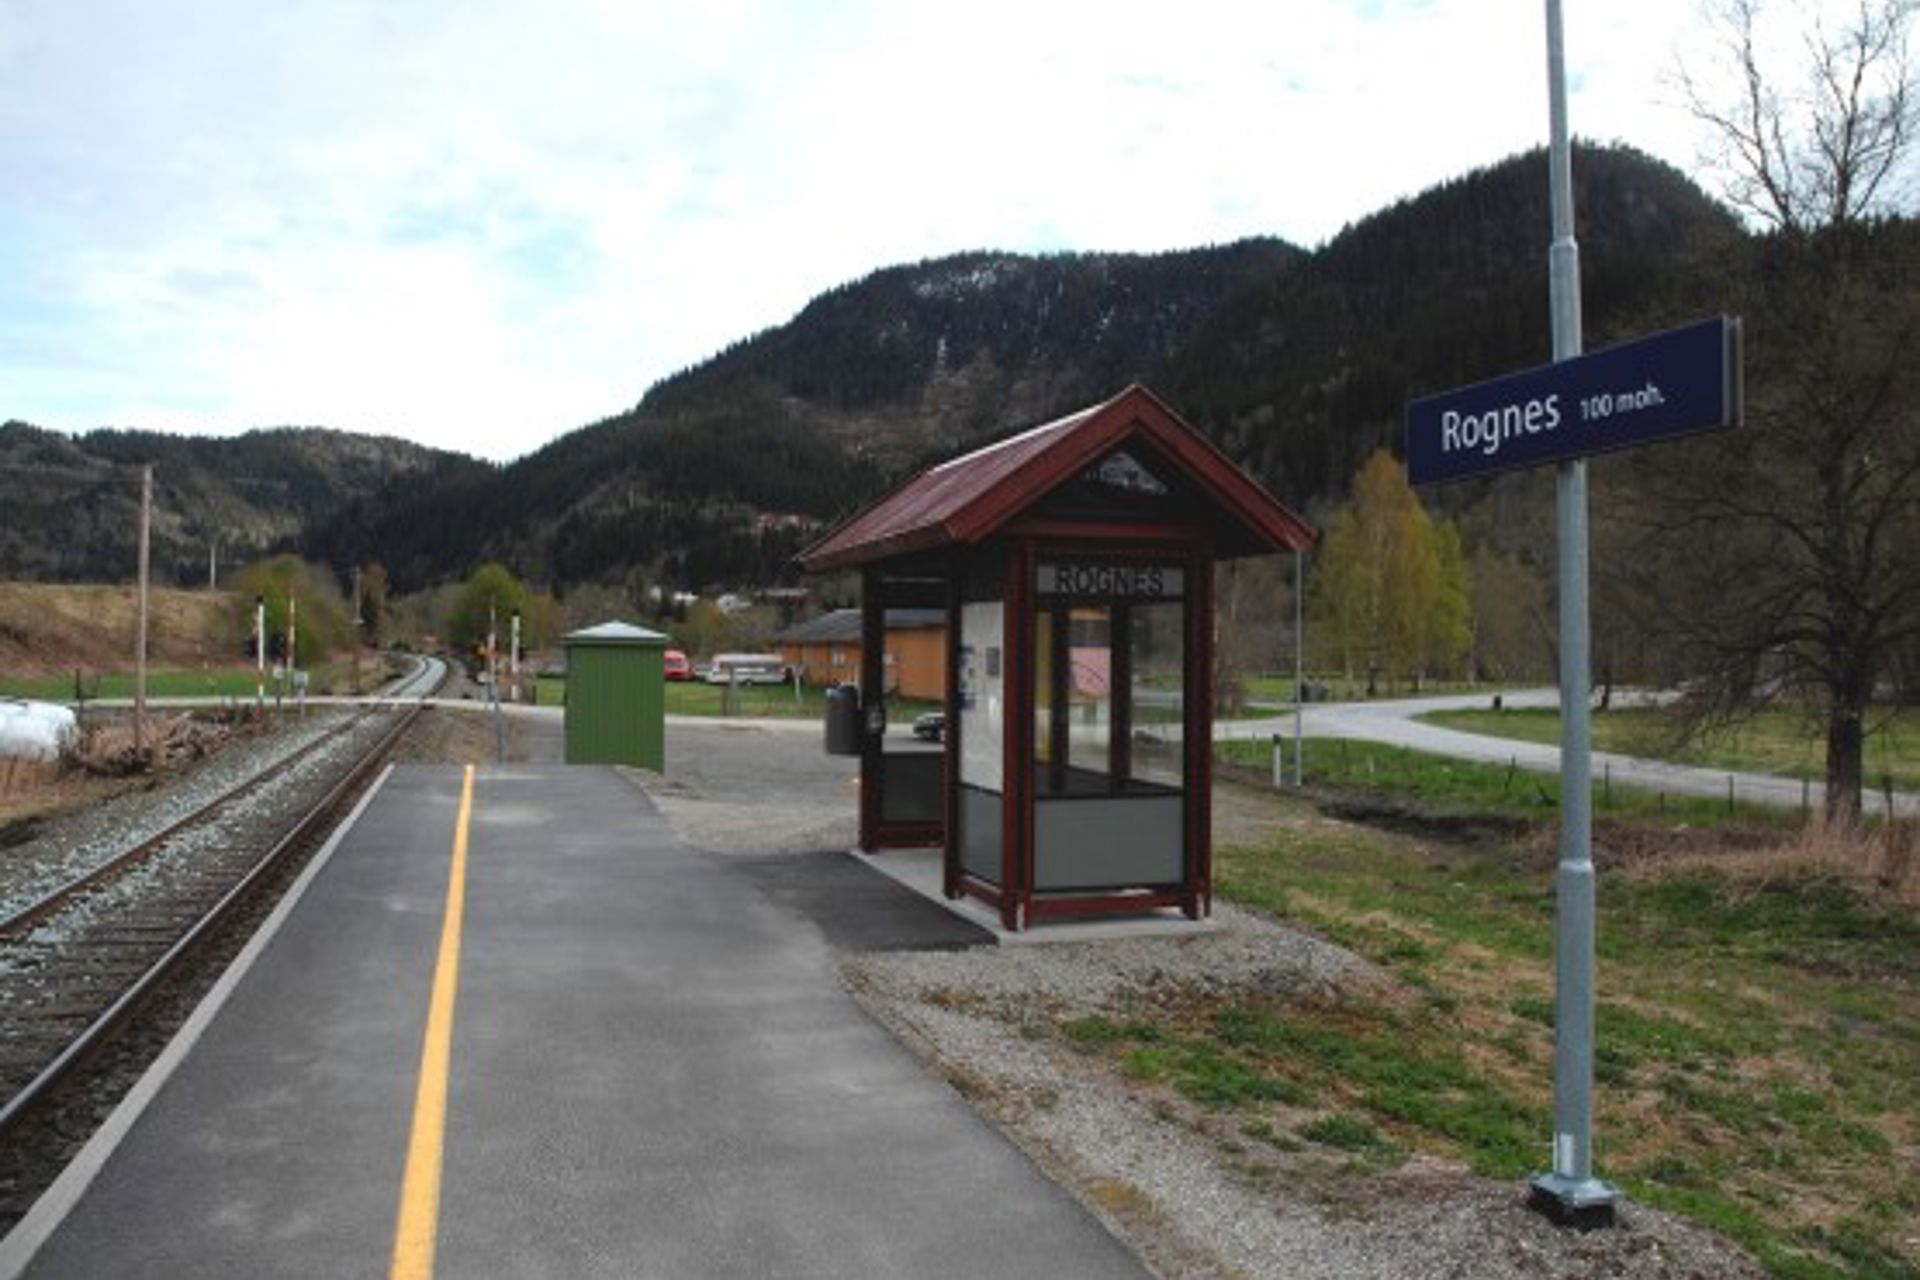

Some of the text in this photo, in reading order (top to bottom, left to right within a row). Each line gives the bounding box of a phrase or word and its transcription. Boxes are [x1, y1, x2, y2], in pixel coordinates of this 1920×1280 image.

[1442, 394, 1560, 455] Rognes
[1580, 394, 1613, 420] 100
[1055, 567, 1164, 594] ROGNES
